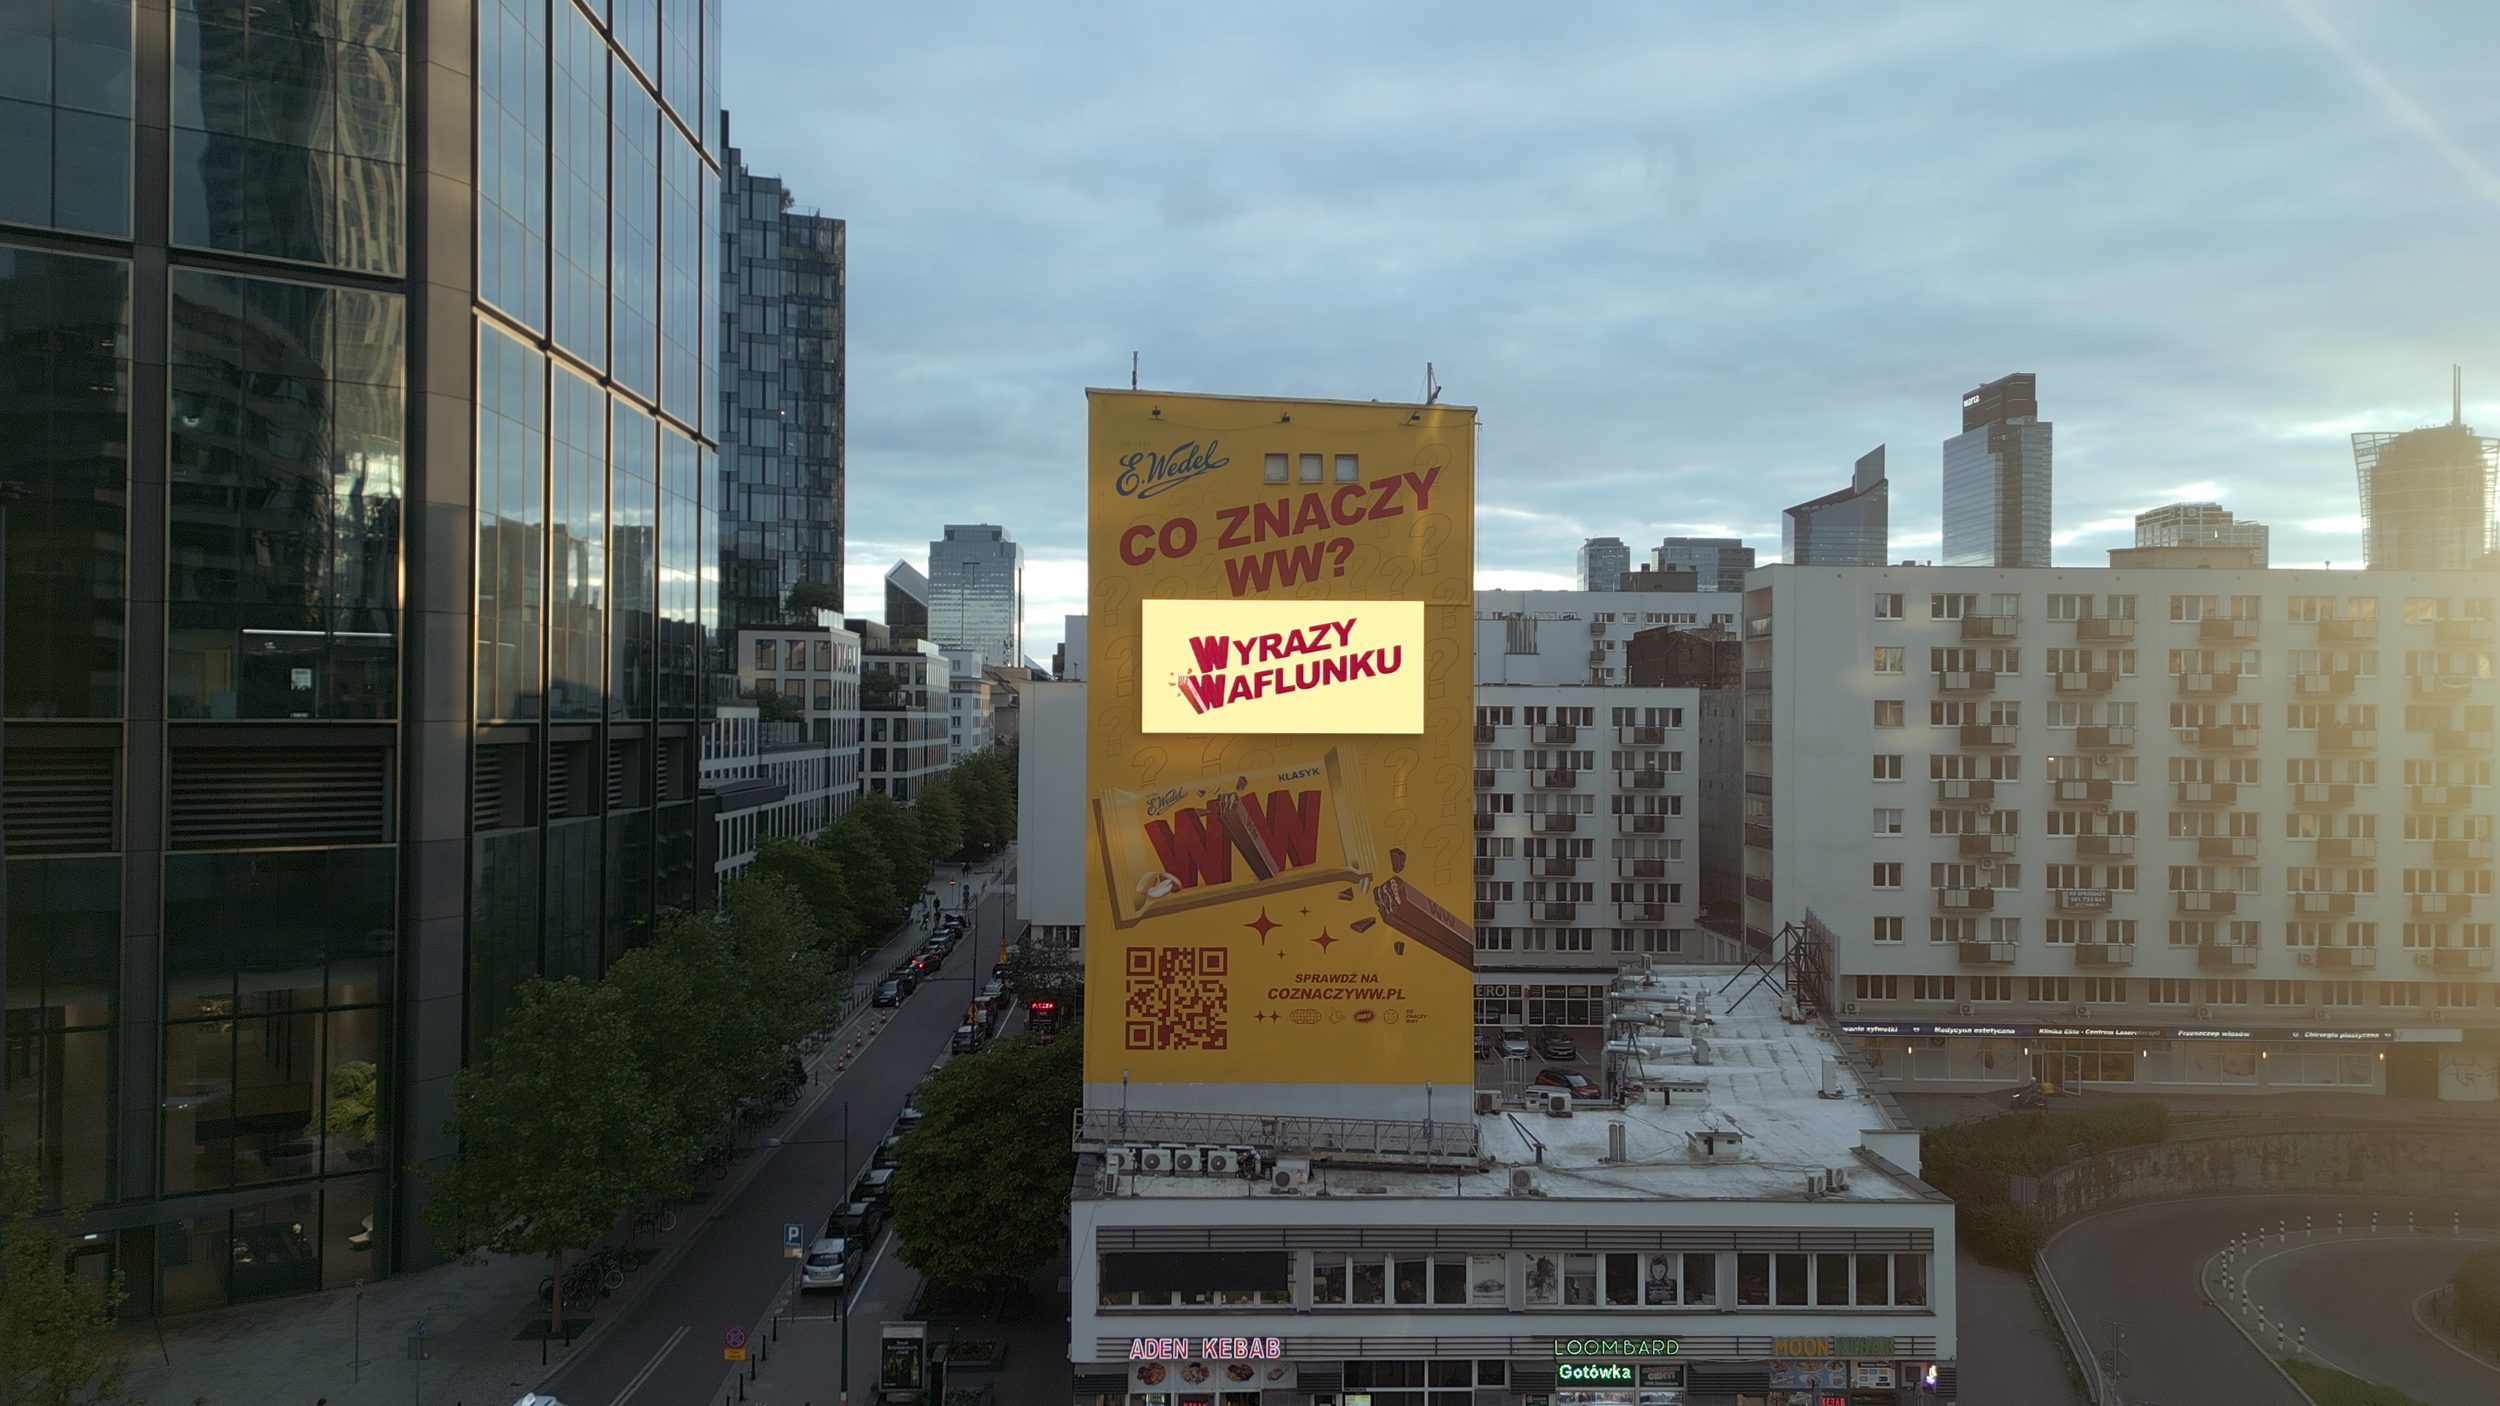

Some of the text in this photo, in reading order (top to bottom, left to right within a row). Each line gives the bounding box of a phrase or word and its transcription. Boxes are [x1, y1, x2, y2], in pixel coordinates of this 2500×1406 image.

[1119, 466, 1441, 566] CO ZNACZY
[1224, 537, 1355, 597] WW?
[1189, 618, 1357, 673] WYRAZY
[1187, 645, 1402, 711] WAFLUNKU
[1278, 767, 1321, 782] KLASYK
[1295, 971, 1379, 983] SPRAWDŹ NA
[1267, 988, 1406, 1000] COZNACZYWW.PL
[1934, 1026, 1973, 1034] Medycyna
[2177, 1029, 2220, 1038] Przeszczep
[2304, 1031, 2380, 1040] Chirurgia plastyczna
[788, 1226, 800, 1241] P
[1129, 1338, 1281, 1359] ADEN KEBAB
[1554, 1339, 1680, 1356] LOOMBARD
[1773, 1336, 1895, 1356] MOON KEBAB
[1558, 1363, 1632, 1380] Gotówka
